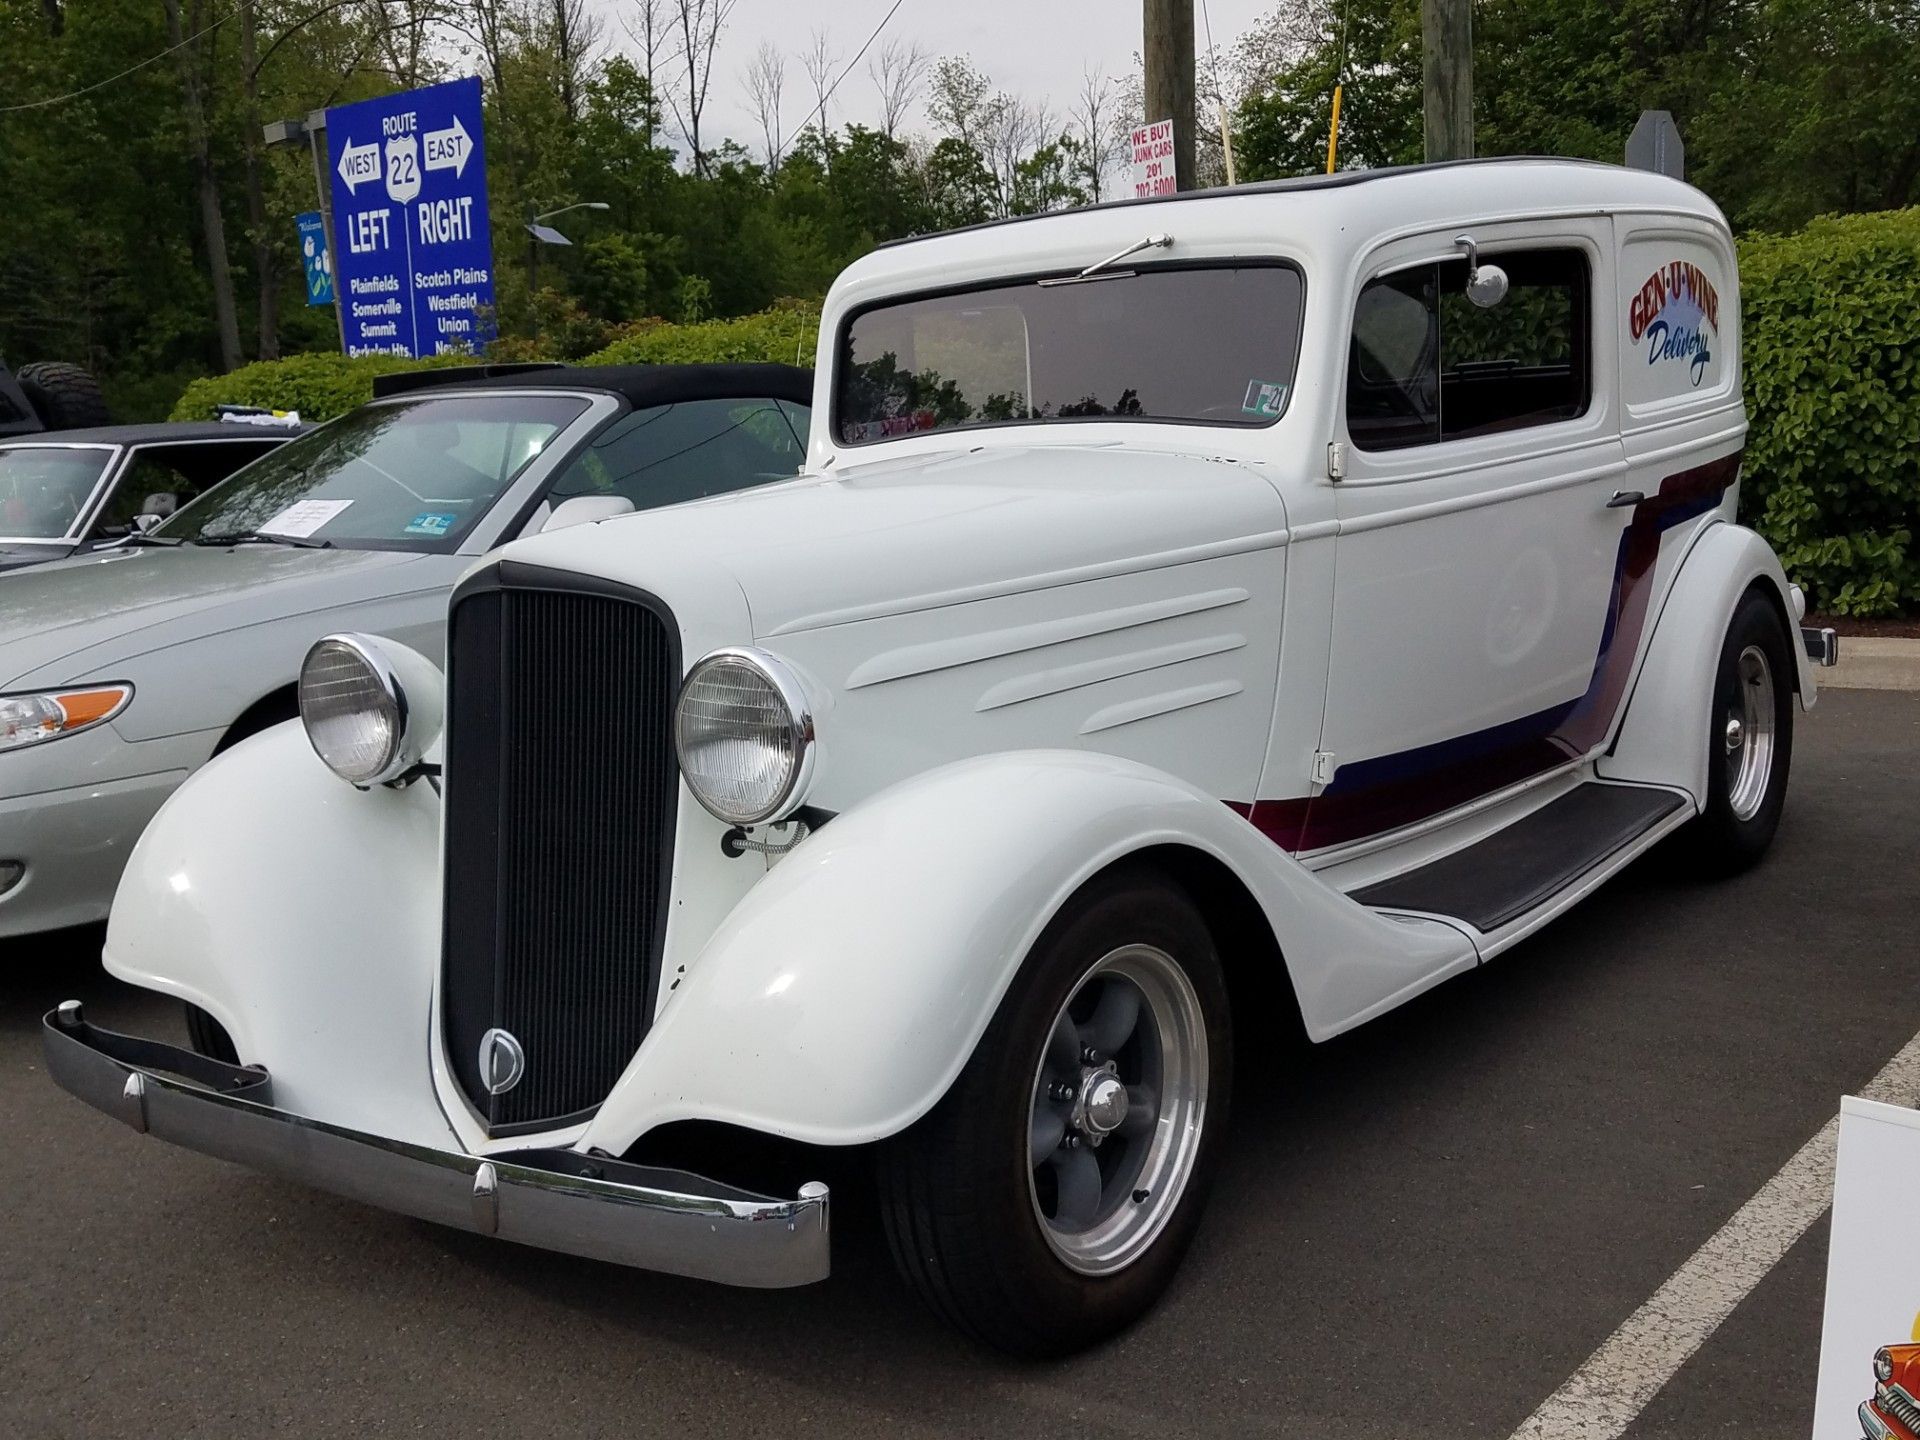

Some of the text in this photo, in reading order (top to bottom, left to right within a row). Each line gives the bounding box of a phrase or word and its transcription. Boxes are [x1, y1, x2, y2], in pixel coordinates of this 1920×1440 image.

[383, 112, 417, 135] ROUTE
[1132, 123, 1170, 146] WE BUY
[428, 135, 463, 161] EAST
[1134, 140, 1172, 163] JUNK CARS
[345, 153, 376, 177] WEST
[390, 154, 415, 186] 22
[1146, 161, 1162, 178] 201
[1136, 176, 1174, 197] 702-6000
[348, 209, 390, 254] LEFT
[418, 196, 473, 245] RIGHT
[351, 274, 399, 294] Plainfields
[415, 267, 488, 289] Scotch Plains
[352, 298, 402, 317] Somerville
[428, 292, 477, 312] Westfield
[360, 321, 397, 338] Summit
[437, 316, 470, 333] Union
[392, 343, 413, 358] Hts.
[1647, 320, 1710, 387] Delivery
